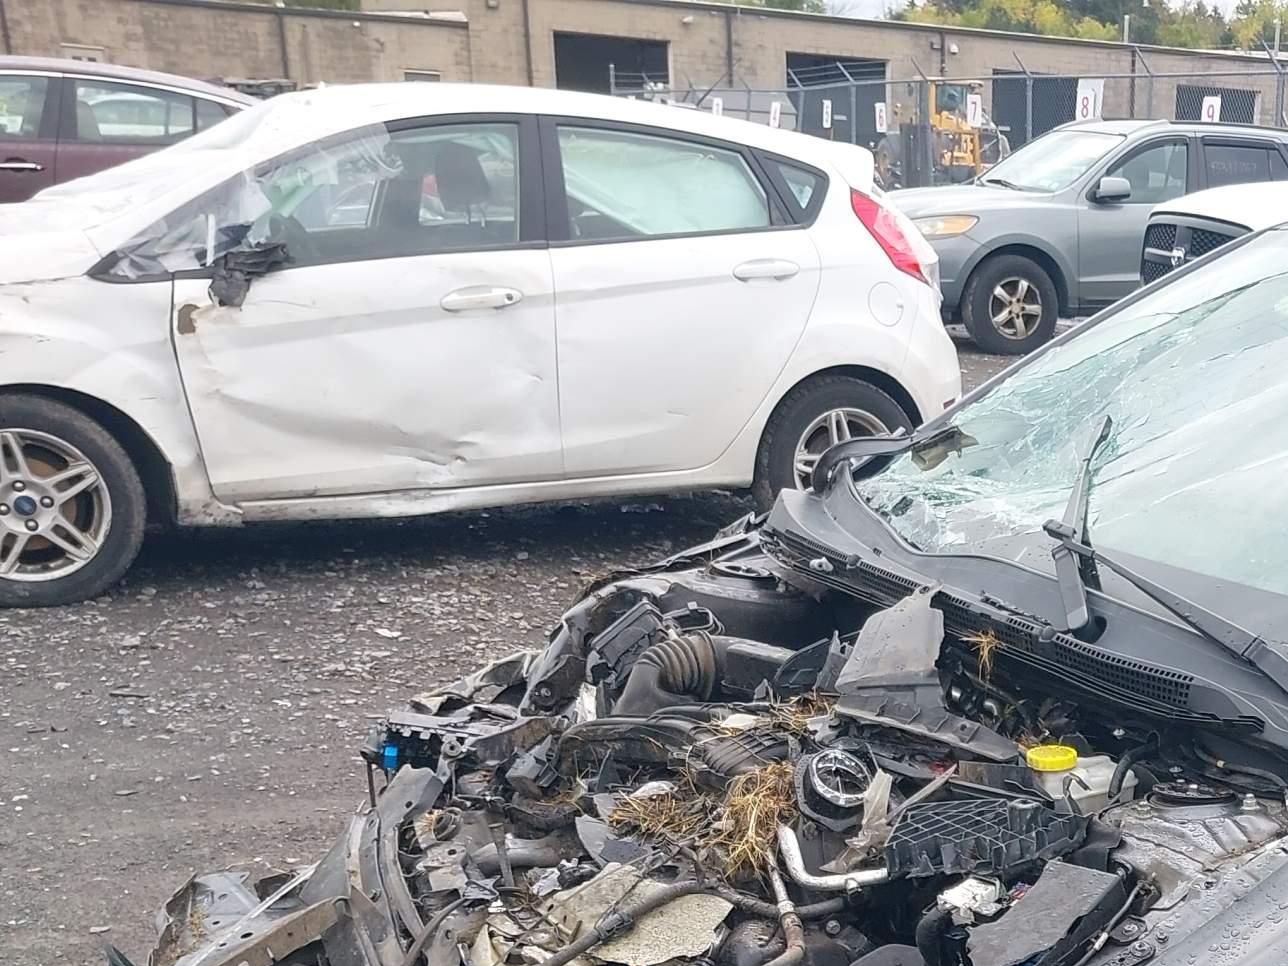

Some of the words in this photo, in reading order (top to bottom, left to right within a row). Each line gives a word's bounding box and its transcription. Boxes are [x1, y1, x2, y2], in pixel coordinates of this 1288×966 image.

[971, 101, 977, 120] 7
[1081, 96, 1089, 118] 8
[1206, 104, 1215, 122] 9
